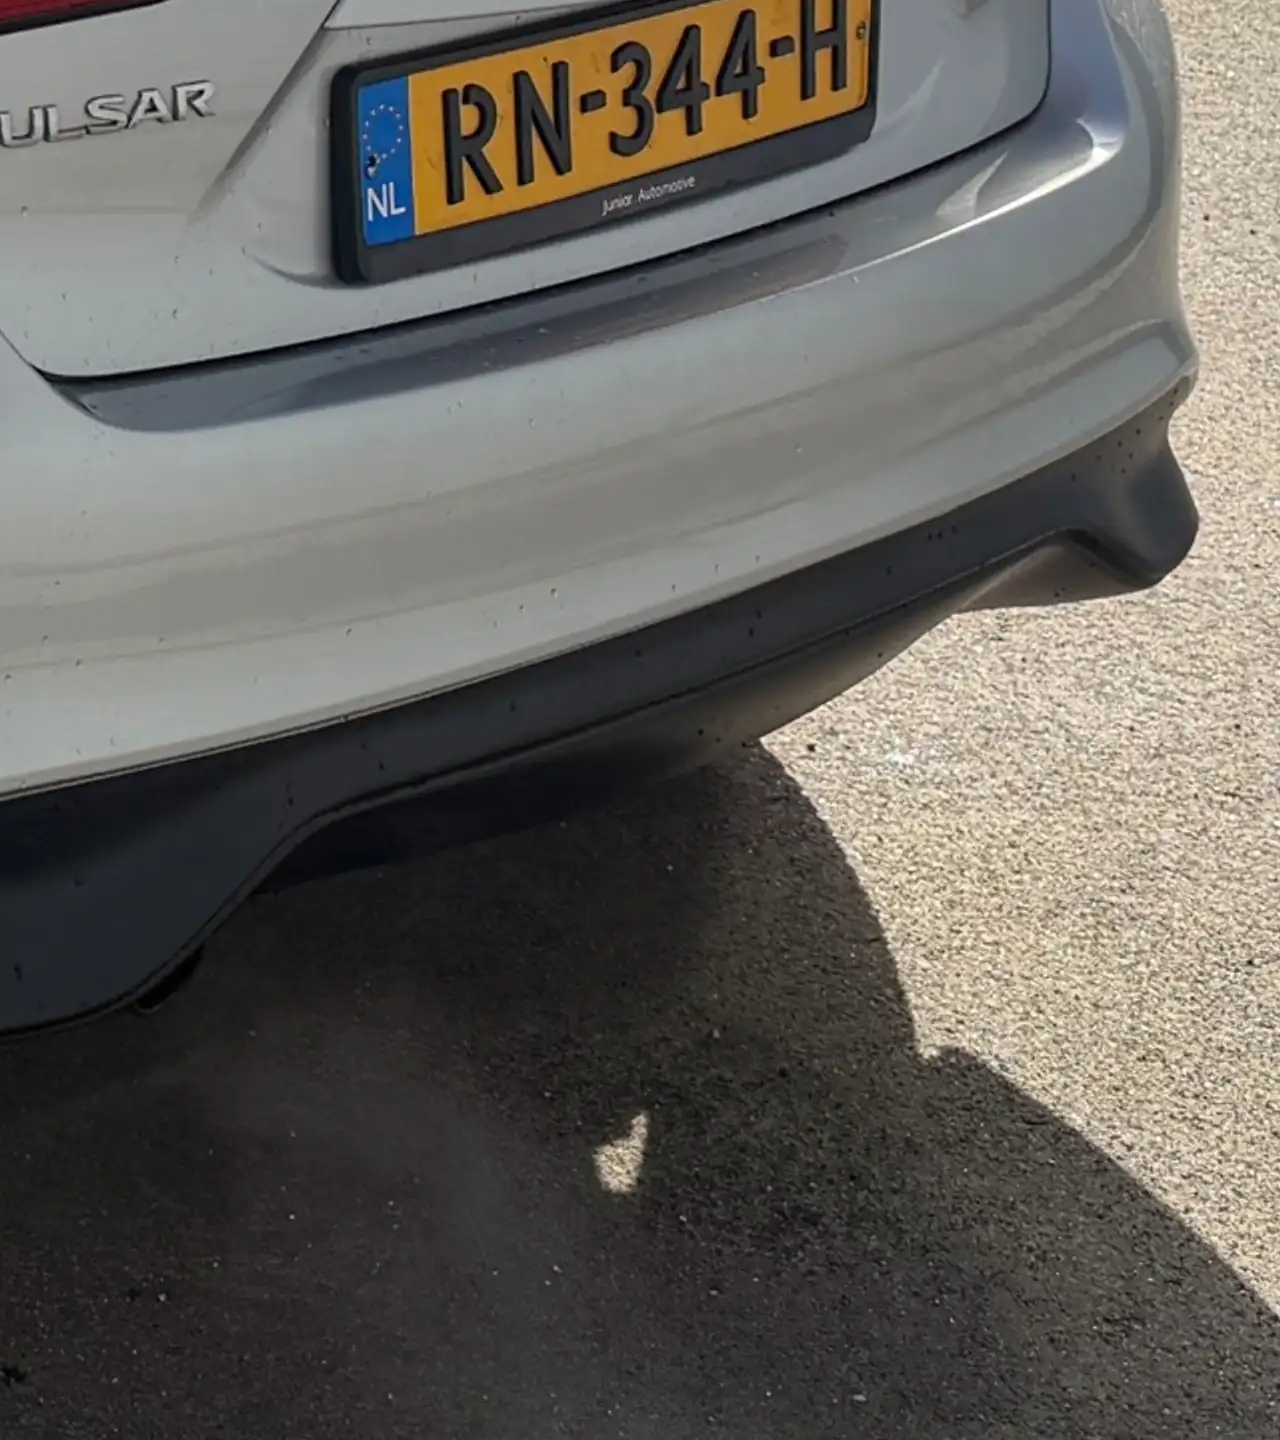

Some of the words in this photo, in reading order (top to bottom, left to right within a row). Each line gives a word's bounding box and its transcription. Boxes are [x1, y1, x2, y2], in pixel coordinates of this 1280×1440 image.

[367, 181, 406, 222] NL
[602, 194, 633, 216] Junior
[638, 176, 695, 202] Automotive
